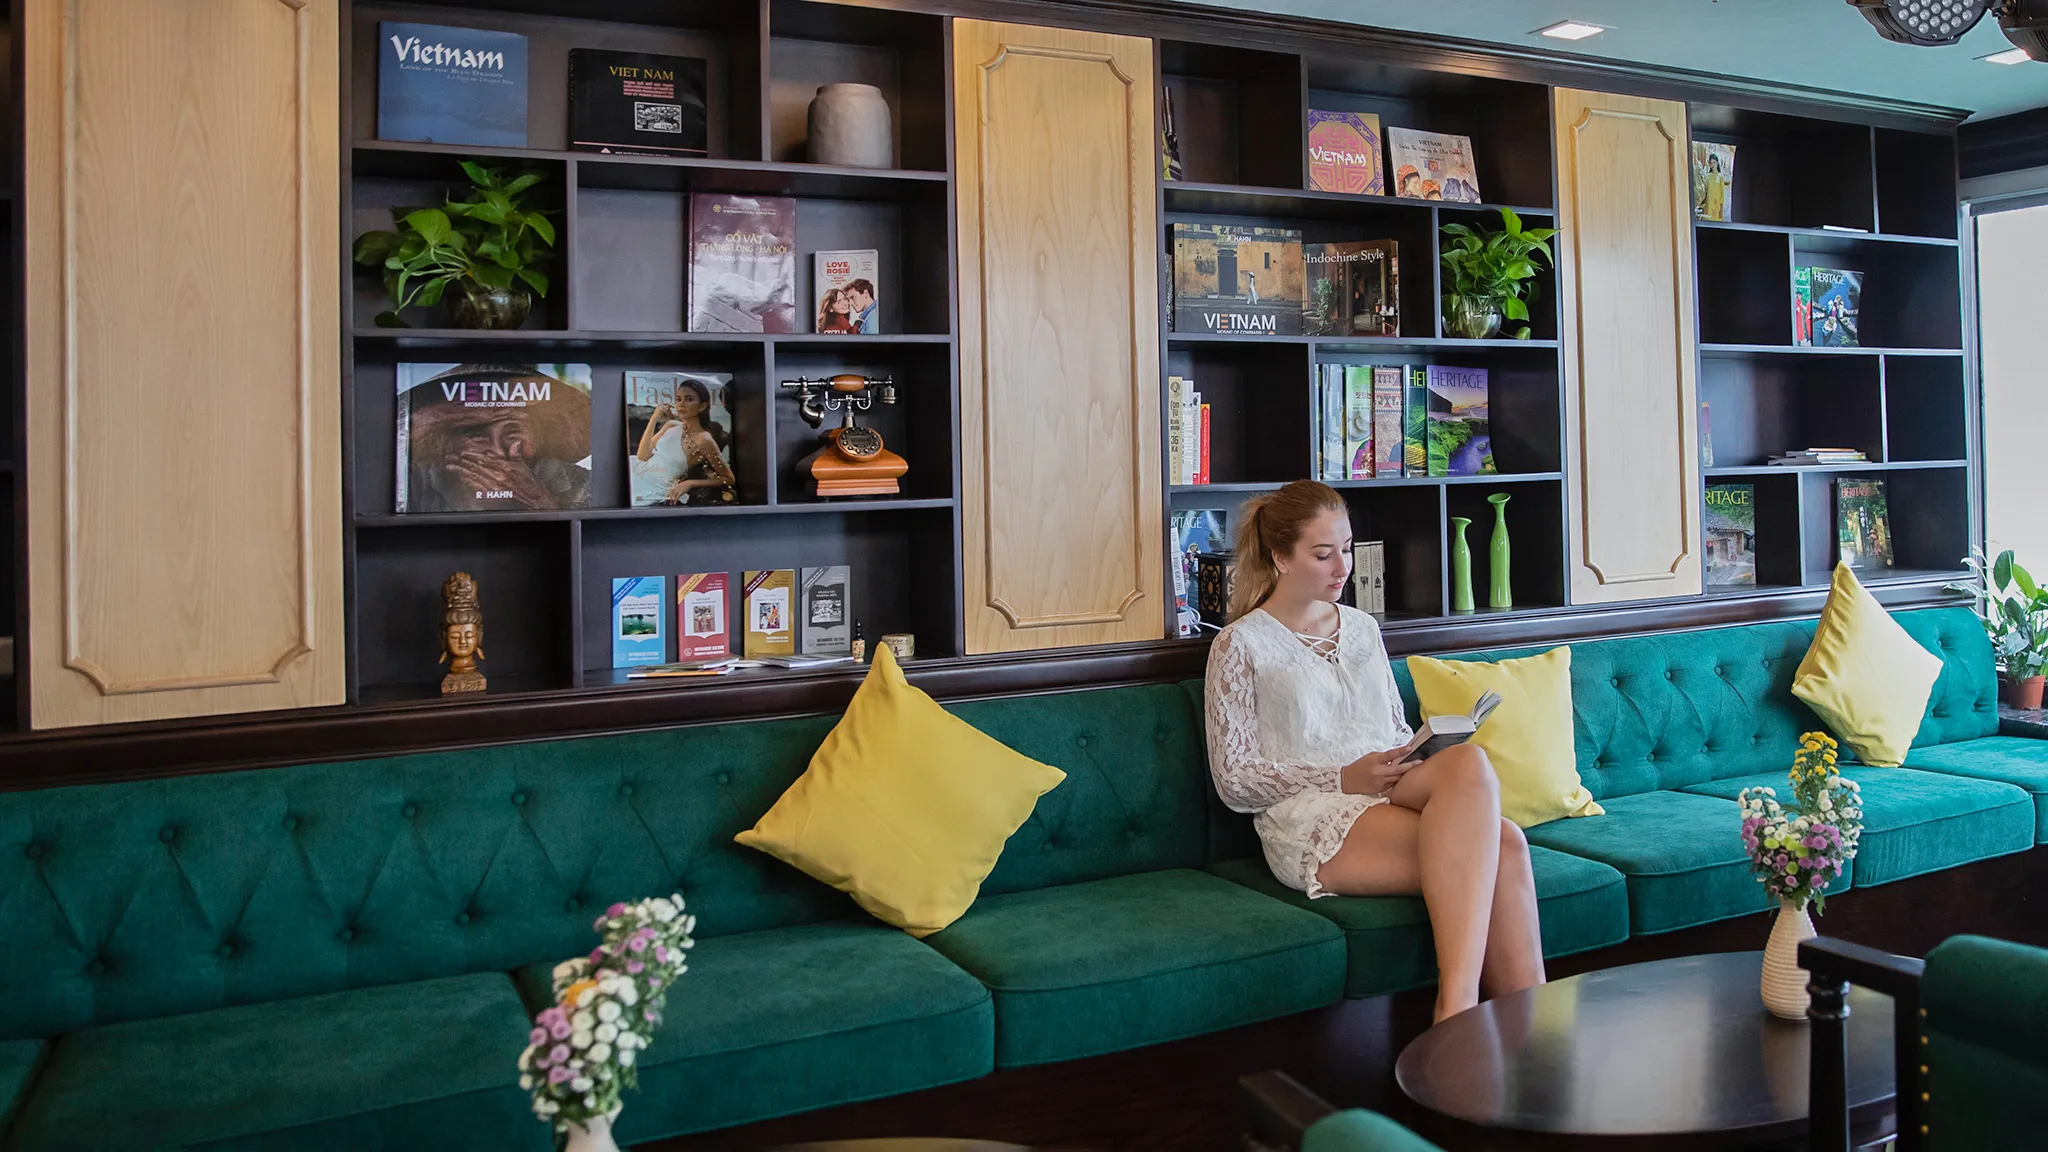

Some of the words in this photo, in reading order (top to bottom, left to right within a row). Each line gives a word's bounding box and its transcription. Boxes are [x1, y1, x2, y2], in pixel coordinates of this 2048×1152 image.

[391, 34, 504, 70] Vietnam
[609, 65, 640, 78] VIET
[644, 68, 674, 80] NAM
[1309, 146, 1367, 168] VIETNAM
[732, 243, 754, 253] LONG
[1306, 252, 1358, 264] Indochine
[1360, 248, 1384, 263] Style
[1814, 271, 1845, 285] HERITAGE
[1203, 312, 1276, 330] VIETNAM
[1430, 369, 1484, 389] HERITAGE
[441, 381, 551, 401] VIETNAM
[1170, 436, 1179, 445] 36
[1841, 486, 1870, 498] HERITAGE
